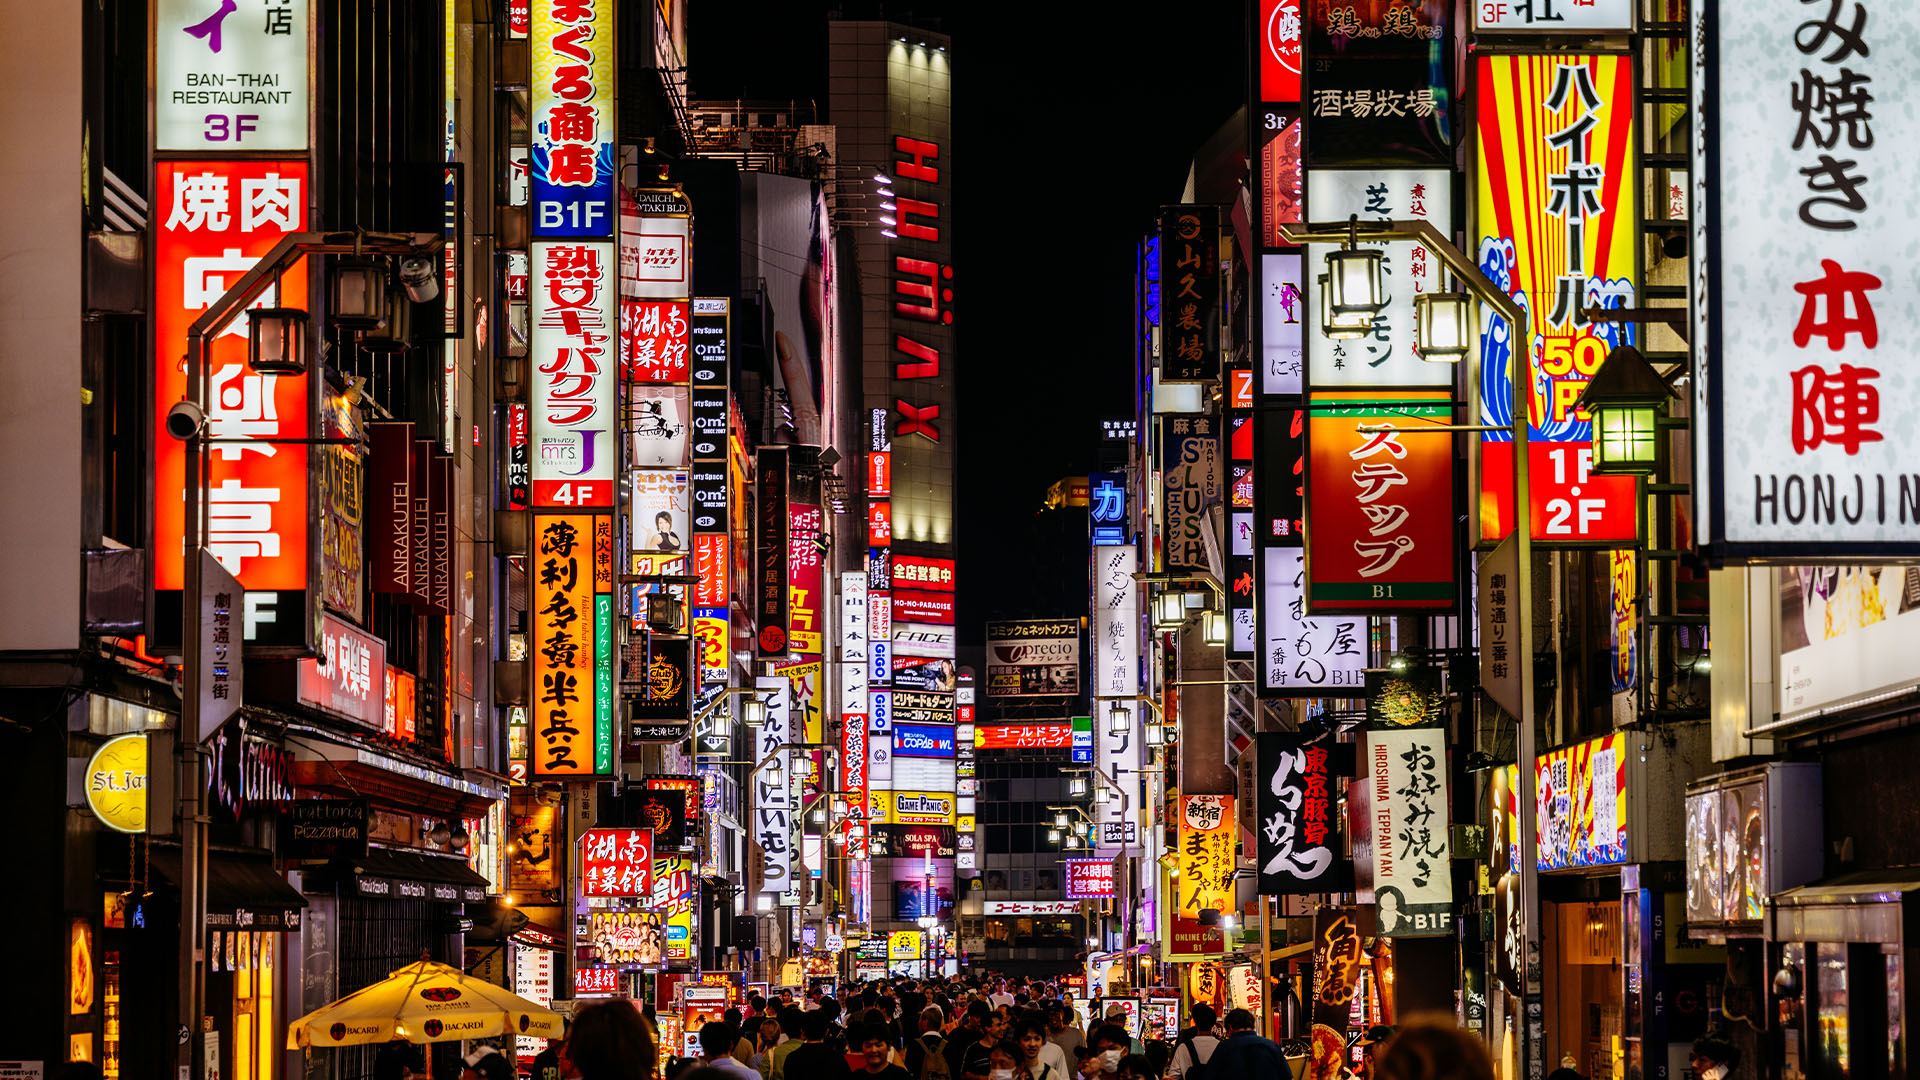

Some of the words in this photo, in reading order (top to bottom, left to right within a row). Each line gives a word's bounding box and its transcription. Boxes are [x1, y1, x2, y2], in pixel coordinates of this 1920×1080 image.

[264, 0, 292, 35] 店
[1483, 4, 1507, 23] 3F
[186, 73, 279, 87] BAN-THAI
[1316, 61, 1333, 72] 2F
[173, 91, 292, 104] RESTAURANT
[1313, 89, 1437, 118] 酒場牧場
[204, 114, 260, 141] 3F
[1264, 113, 1287, 130] 3F
[165, 172, 300, 232] 焼肉
[1543, 64, 1605, 330] ハイボール
[540, 201, 605, 228] B1F
[642, 257, 679, 265] ラウンジ
[646, 248, 678, 256] カブキ
[1411, 246, 1426, 293] 肉刺し
[1176, 244, 1203, 361] 山久農場
[539, 246, 608, 426] 熟女キャバクラ
[634, 305, 687, 338] 湖南
[634, 338, 687, 369] 菜館
[1543, 337, 1606, 376] 50
[1790, 258, 1884, 456] 本陣
[651, 370, 671, 379] 4F
[1173, 418, 1210, 435] 麻雀
[1233, 419, 1243, 427] 4F
[1234, 468, 1246, 477] 3F
[553, 484, 593, 505] 4F
[1349, 422, 1415, 578] ステップ
[1754, 473, 1920, 525] HONJIN
[1169, 494, 1182, 563] エスラッシュ
[1546, 498, 1606, 534] 2F
[393, 482, 408, 587] ANRAKUTEI
[414, 497, 429, 599] ANRAKUTEI
[435, 512, 449, 609] ANRAKUTEI
[596, 522, 611, 582] 炭火串焼
[715, 537, 723, 576] レンタルルーム
[697, 537, 711, 605] リフレッシュ
[893, 563, 952, 583] 全店営業中
[715, 580, 723, 602] ホステル
[1372, 585, 1393, 598] B1
[699, 609, 714, 617] 1F
[1490, 573, 1509, 679] 劇場通り一番街
[991, 625, 1076, 636] コミック&ネットカフェ
[1324, 623, 1361, 655] 屋
[212, 592, 231, 700] 劇場通り一番街
[875, 644, 886, 677] GiGO
[340, 633, 370, 700] 安楽亭
[650, 669, 671, 678] Club
[1270, 637, 1288, 686] 一番街
[1332, 670, 1364, 685] B1F
[875, 694, 886, 728] GiGO
[893, 693, 953, 709] ビリヤード&ダーツ
[634, 727, 684, 736] 第一大滝ビル
[1017, 737, 1064, 747] ハンバーグ
[847, 716, 864, 786] 横浜家系
[1375, 745, 1390, 802] HIROSHIMA
[1303, 745, 1329, 845] 東京豚骨
[1188, 803, 1220, 821] 新宿
[1199, 818, 1210, 829] の
[1396, 742, 1446, 888] お好み焼き
[588, 830, 647, 864] 湖南
[905, 834, 922, 842] SOLA
[600, 866, 647, 895] 菜館
[1074, 865, 1113, 877] 24時間
[1186, 832, 1210, 910] まっちゃん
[1074, 880, 1113, 893] 営業中
[995, 903, 1030, 913] コーヒー
[1415, 913, 1450, 930] B1F
[1194, 944, 1202, 952] B1
